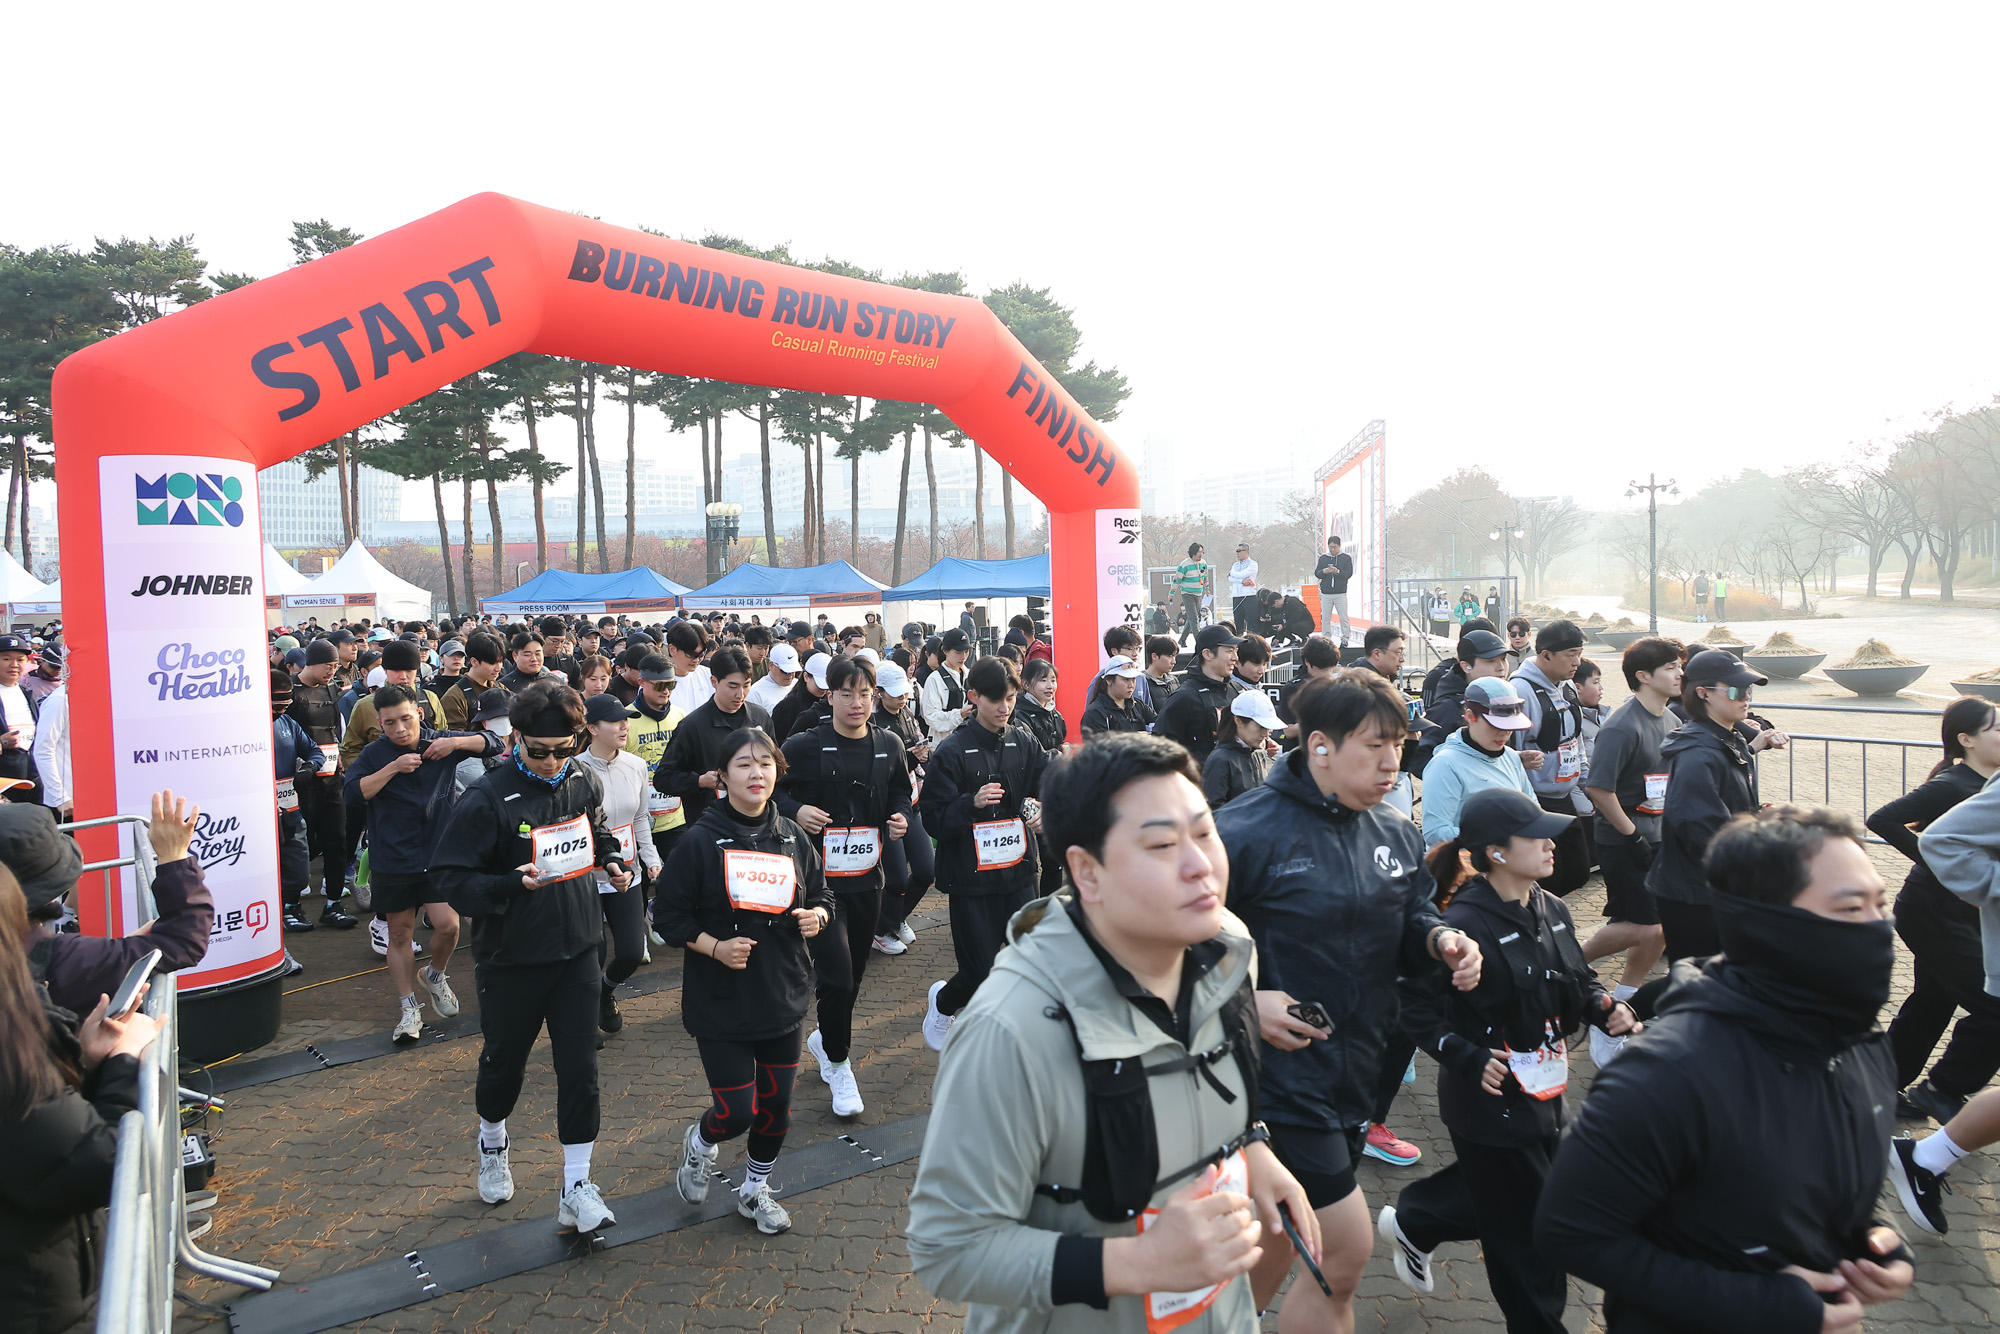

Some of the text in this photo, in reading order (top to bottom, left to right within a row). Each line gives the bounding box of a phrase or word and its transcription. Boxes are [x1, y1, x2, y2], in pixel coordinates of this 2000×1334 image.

[567, 239, 956, 349] BURNING RUN STORY
[251, 256, 501, 422] START
[771, 330, 940, 370] Casual Running Festival
[1006, 360, 1116, 487] FINISH
[131, 575, 253, 597] JOHNBER
[721, 598, 772, 606] 사회자대기실
[157, 642, 245, 671] Choco
[148, 664, 252, 701] Health
[133, 741, 267, 764] KN INTERNATIONAL
[184, 812, 241, 841] Run
[187, 835, 247, 866] Story
